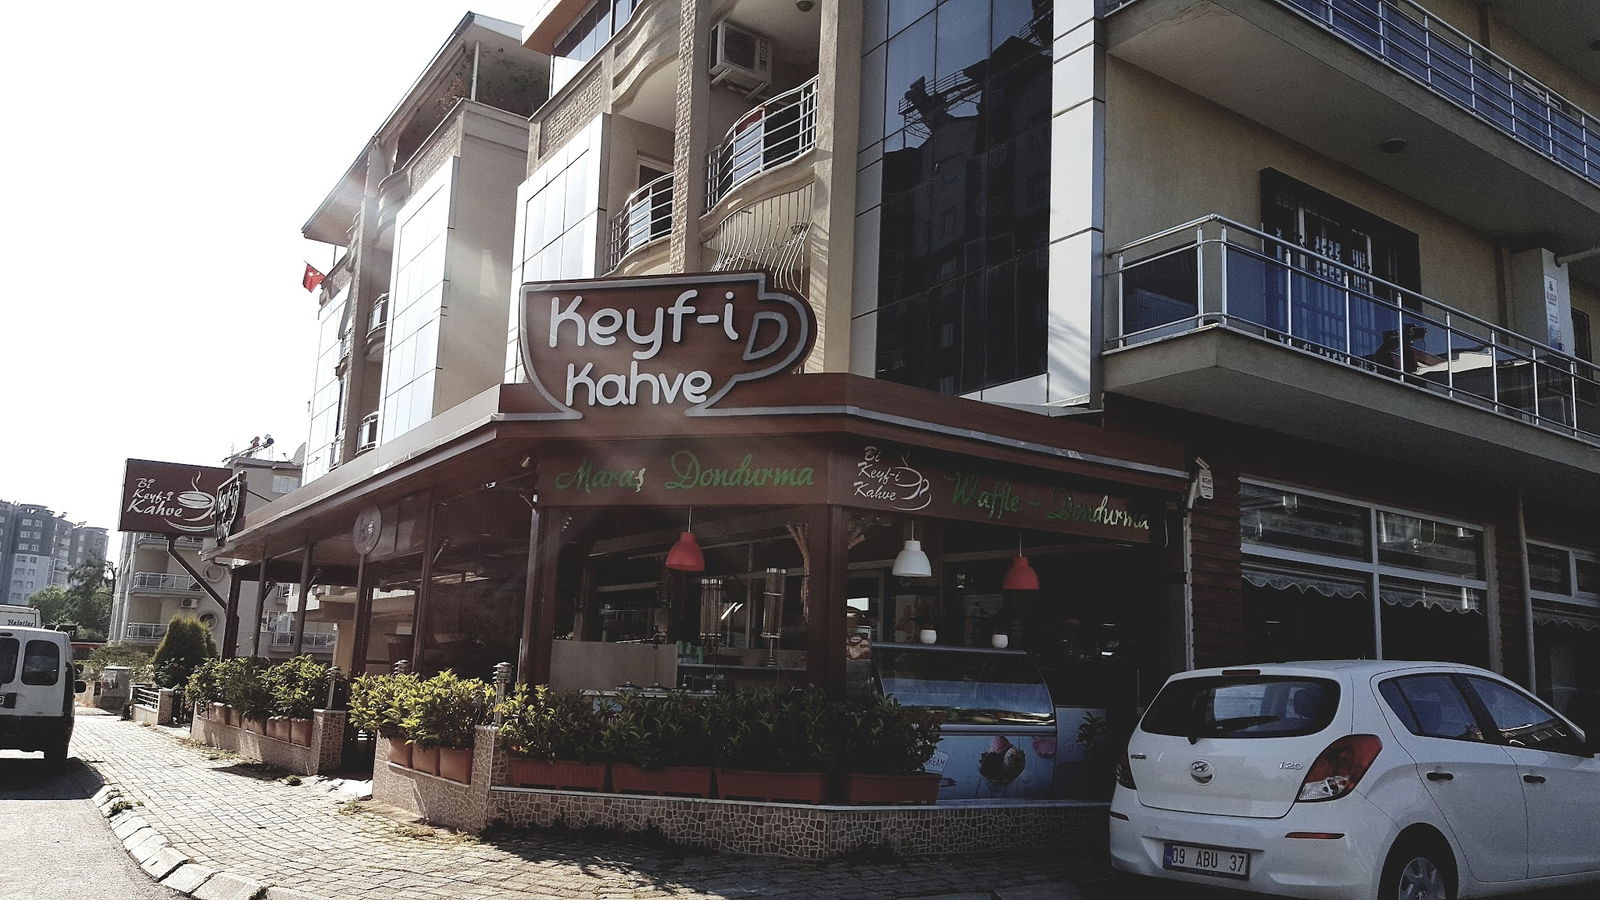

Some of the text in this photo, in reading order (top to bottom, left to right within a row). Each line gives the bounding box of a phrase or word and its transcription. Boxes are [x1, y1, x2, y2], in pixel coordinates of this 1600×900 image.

[549, 289, 739, 360] Keyf-i
[565, 360, 712, 407] Kahve
[864, 446, 881, 462] Bi
[664, 450, 815, 490] Dondurma
[857, 461, 901, 485] Keyf-i
[136, 477, 156, 489] Bi
[853, 481, 896, 501] Kahve
[126, 499, 183, 517] Kahve
[132, 488, 174, 504] Keyf-i
[944, 470, 1021, 520] Waffle
[1046, 486, 1150, 530] Dondurma
[1172, 847, 1245, 873] 09 ABU 37
